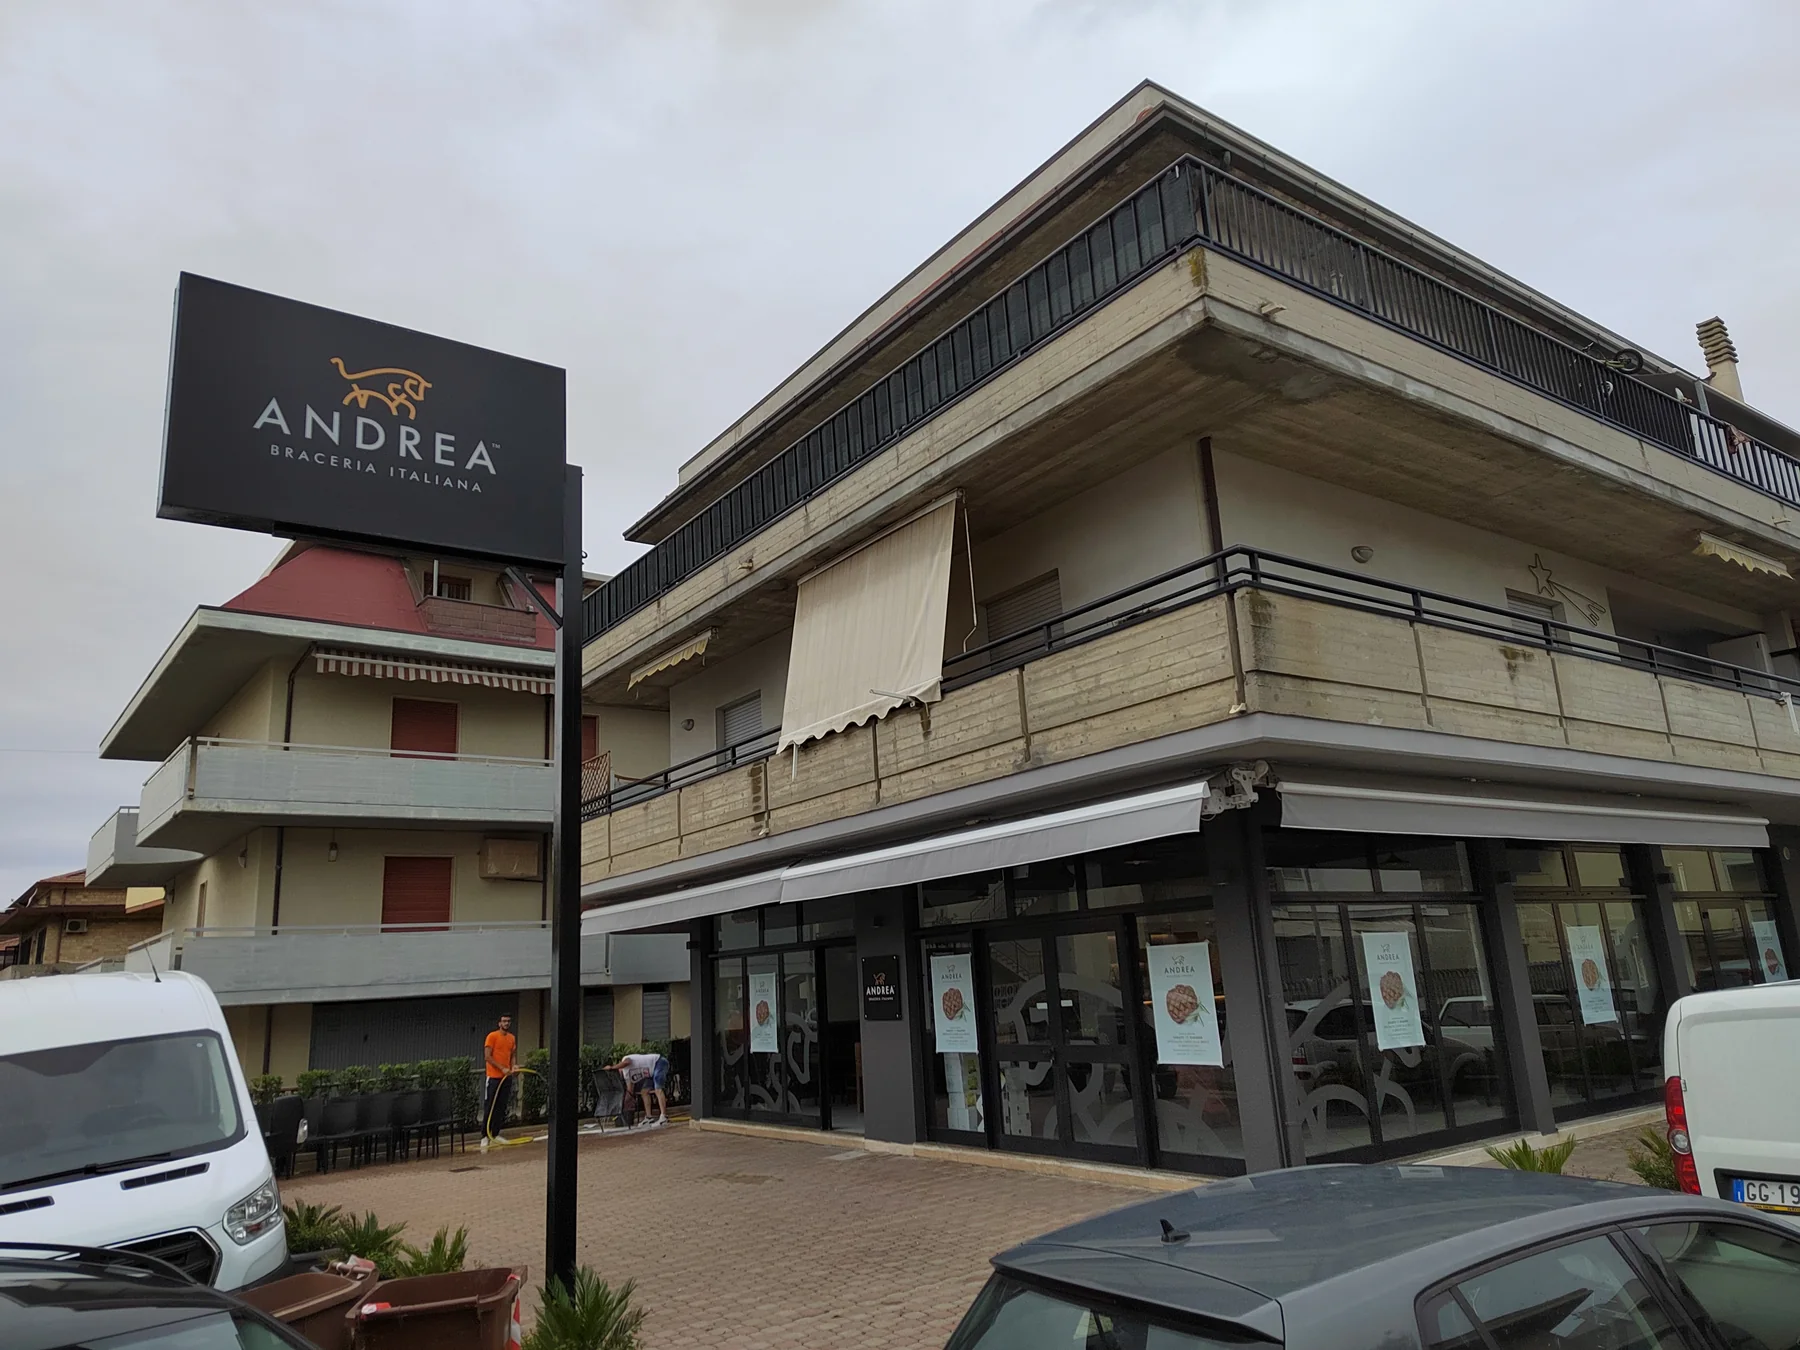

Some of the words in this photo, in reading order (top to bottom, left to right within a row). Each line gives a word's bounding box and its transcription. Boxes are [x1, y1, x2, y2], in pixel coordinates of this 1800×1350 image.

[253, 397, 497, 475] ANDREA
[270, 444, 377, 474] BRACERIA
[390, 466, 482, 493] ITALIANA
[1164, 966, 1195, 975] ANDREA
[866, 985, 894, 995] ANDREA
[1746, 1182, 1770, 1202] GG
